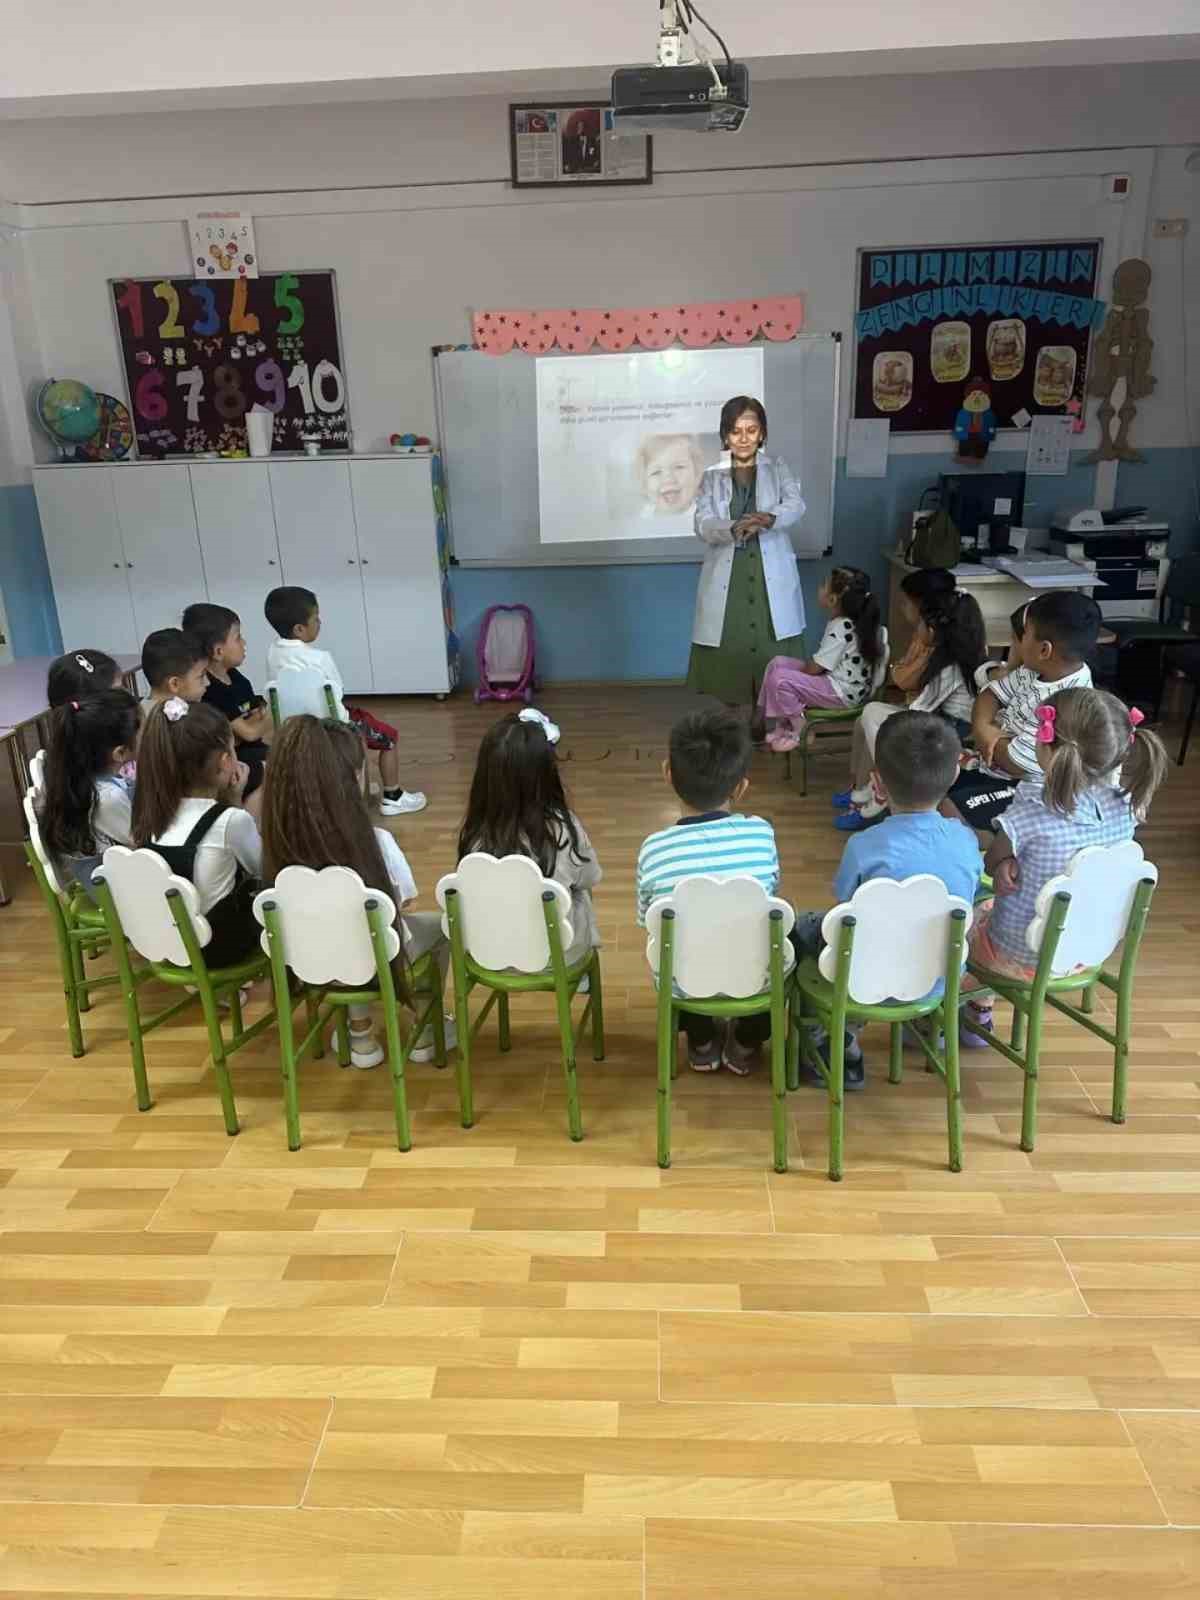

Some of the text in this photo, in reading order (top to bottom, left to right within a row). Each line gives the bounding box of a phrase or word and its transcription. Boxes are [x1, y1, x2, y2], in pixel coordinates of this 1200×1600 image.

[240, 225, 249, 237] 5
[117, 278, 144, 337] 1
[153, 279, 185, 338] 2
[189, 279, 221, 336] 3
[274, 273, 305, 334] 5
[135, 358, 345, 422] 6 7 8 9 10
